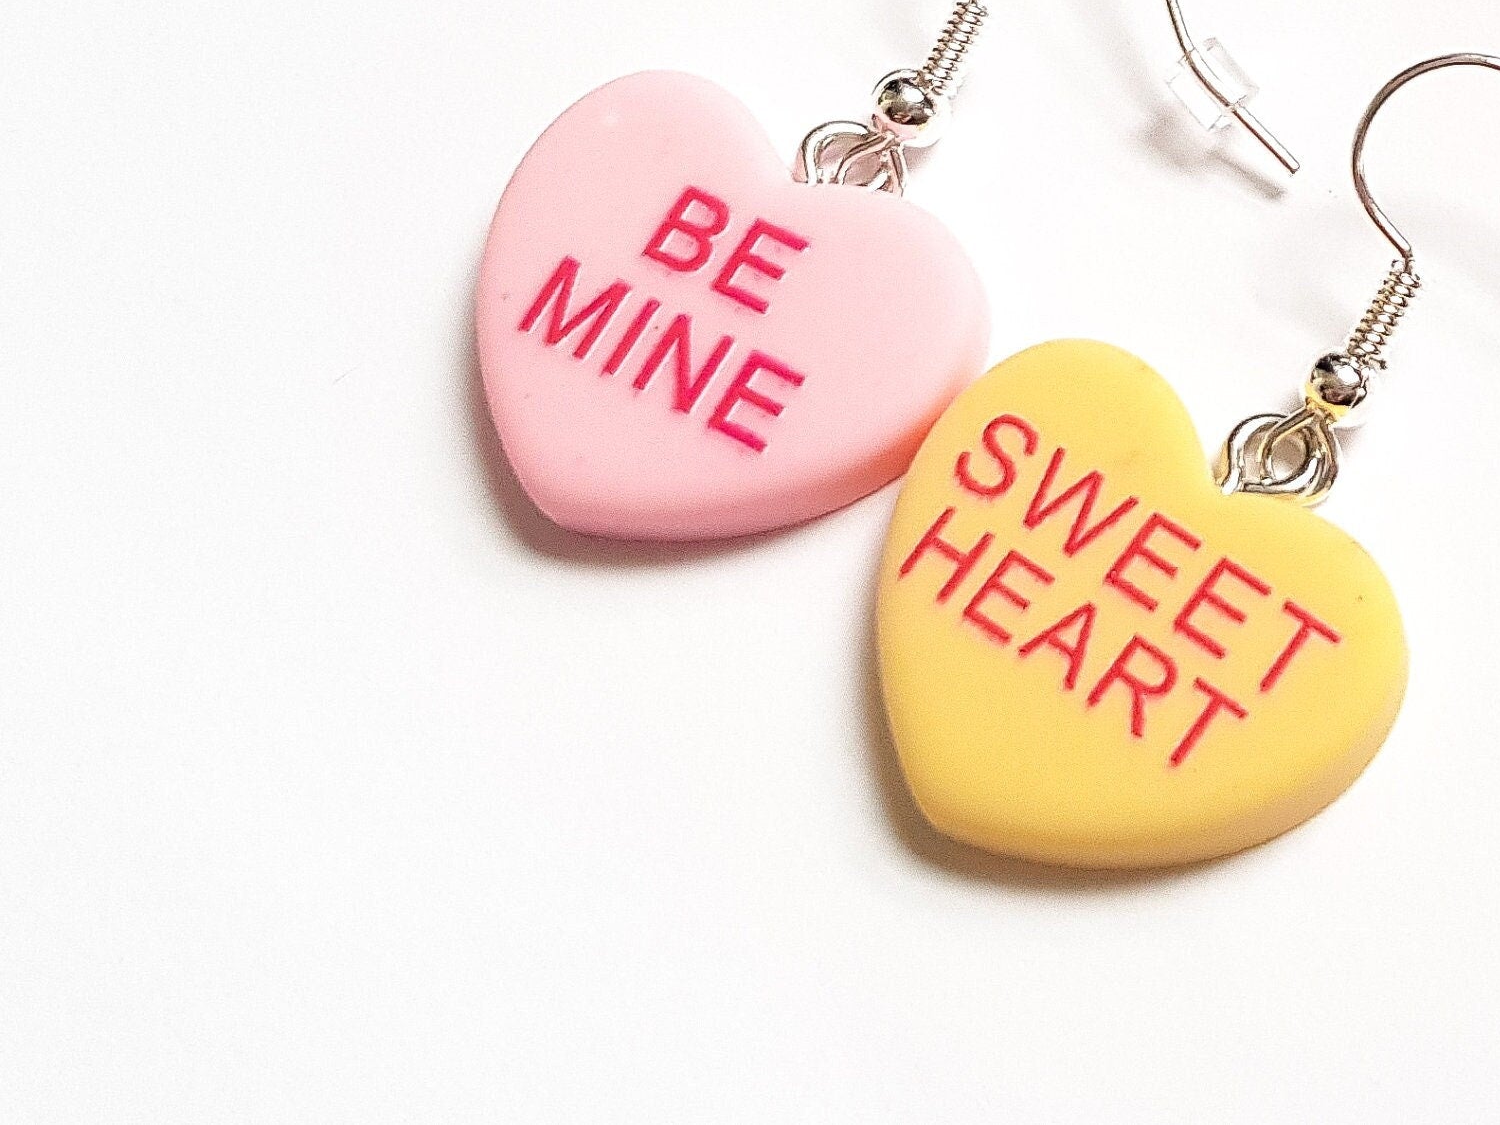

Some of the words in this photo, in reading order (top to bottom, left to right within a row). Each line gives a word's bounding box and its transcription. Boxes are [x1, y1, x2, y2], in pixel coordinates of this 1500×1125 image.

[517, 256, 806, 453] MINE
[641, 185, 810, 315] BE
[899, 506, 1248, 768] HEART
[953, 413, 1341, 692] SWEET
